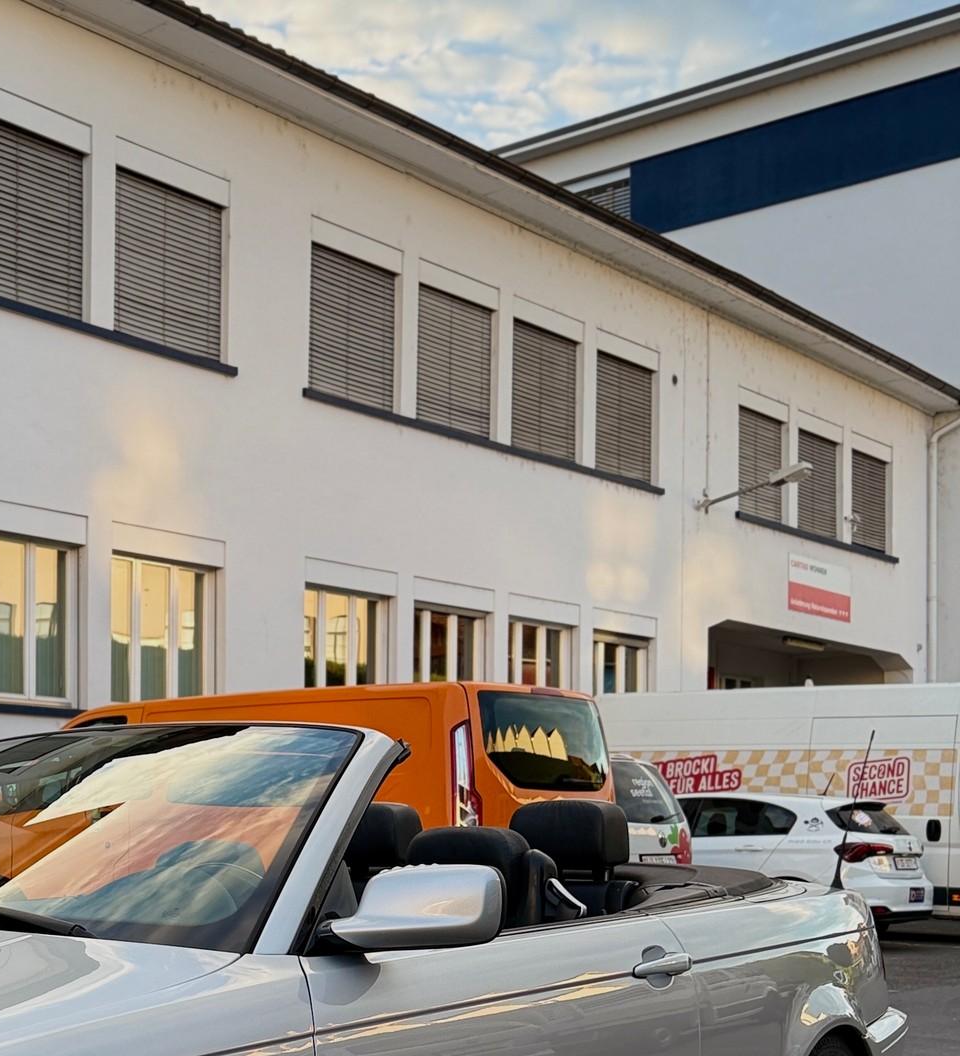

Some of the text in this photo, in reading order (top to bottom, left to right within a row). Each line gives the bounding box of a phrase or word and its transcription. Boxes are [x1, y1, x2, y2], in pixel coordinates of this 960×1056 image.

[666, 757, 715, 779] BROCKI
[852, 762, 905, 781] SECOND
[698, 771, 739, 792] ALLES
[852, 778, 904, 799] CHANCE
